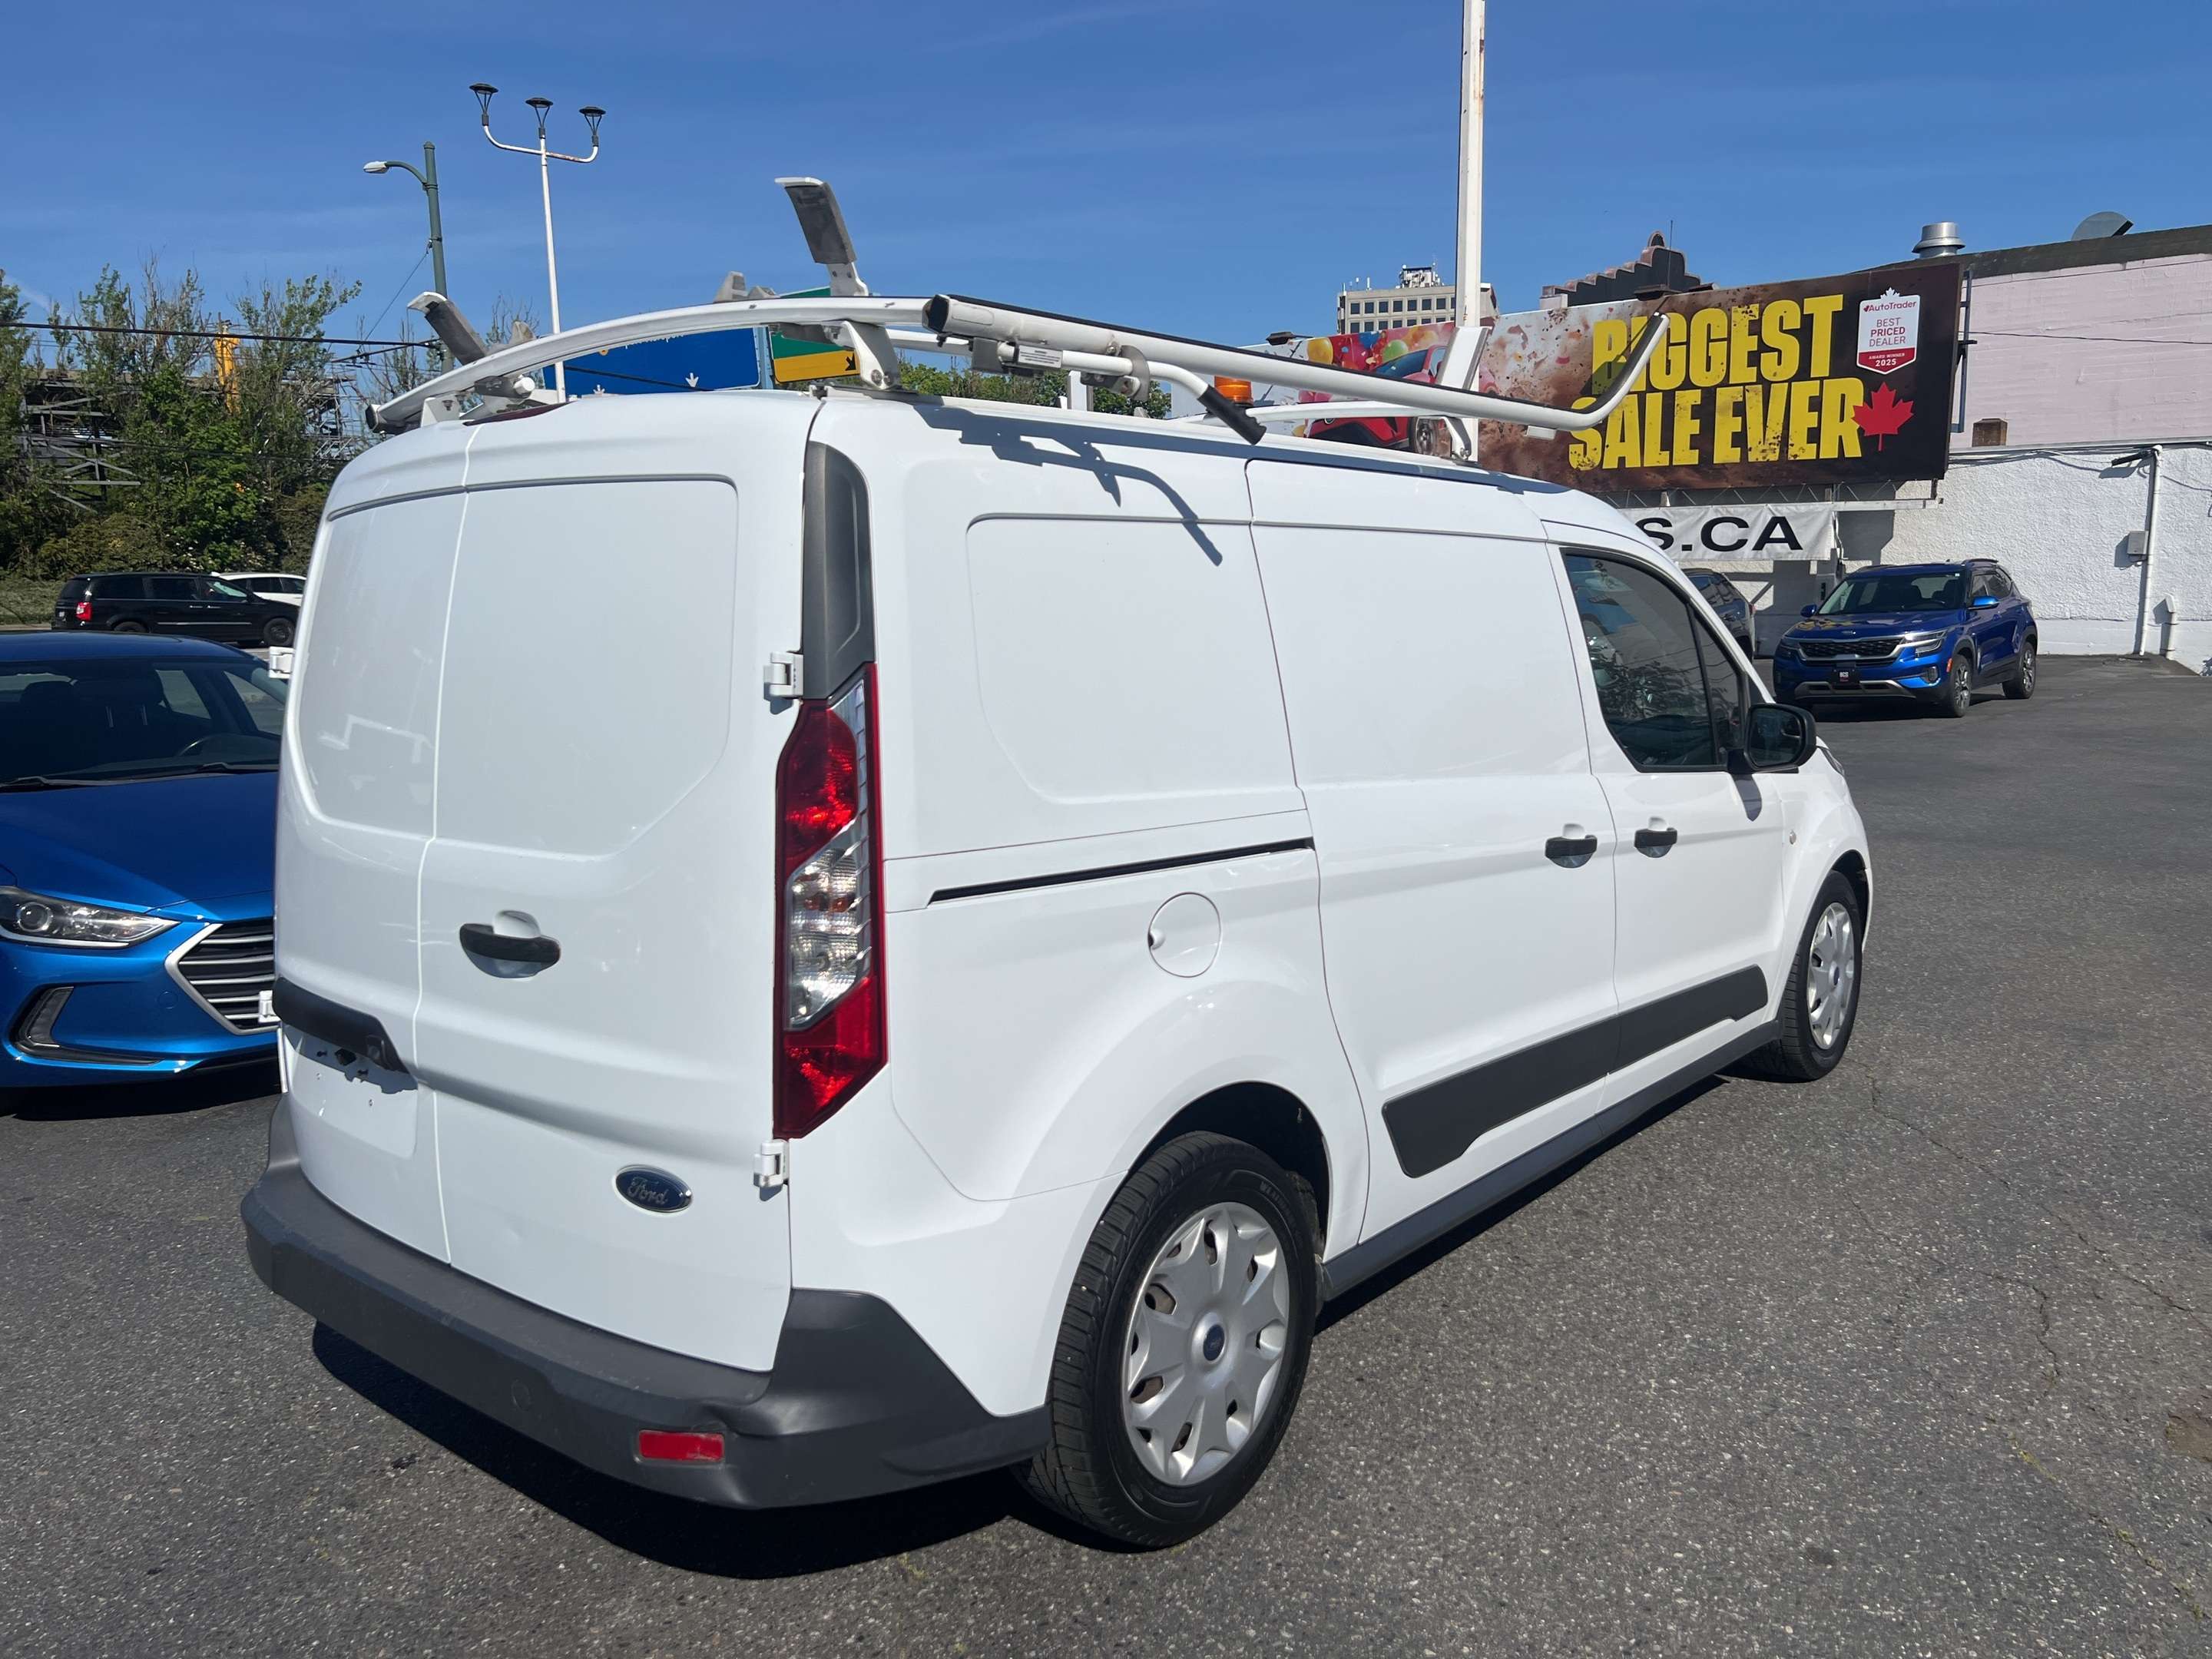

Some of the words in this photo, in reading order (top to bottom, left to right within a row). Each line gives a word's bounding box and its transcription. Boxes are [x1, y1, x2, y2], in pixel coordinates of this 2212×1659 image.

[1868, 301, 1916, 311] AutoTrader
[1876, 316, 1901, 328] BEST
[1870, 326, 1906, 337] PRICED
[1869, 336, 1906, 347] DEALER
[1875, 358, 1896, 366] 2025
[1568, 389, 1702, 471] SALE
[1714, 377, 1864, 465] EVER
[628, 1176, 669, 1205] Ford
